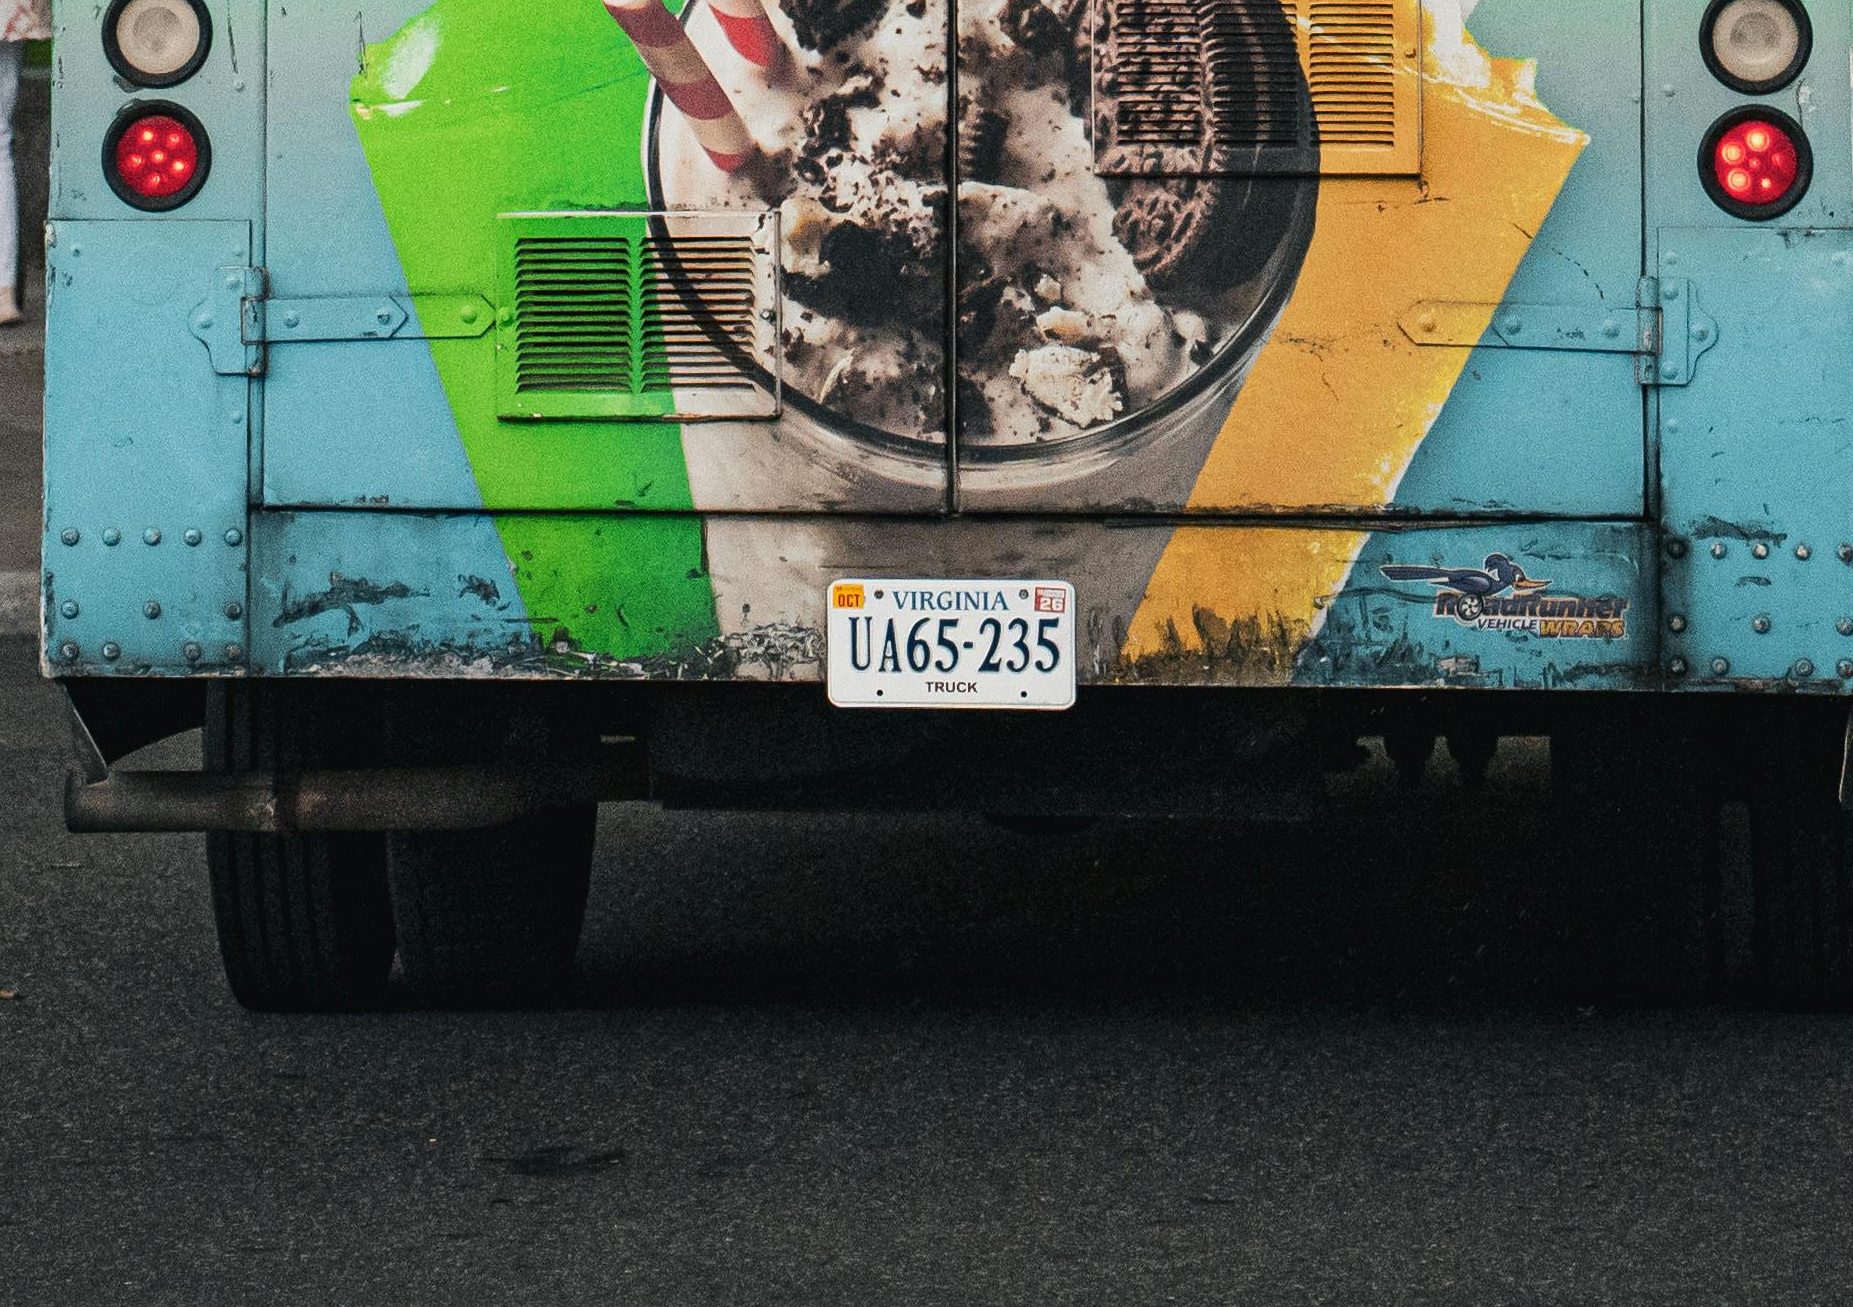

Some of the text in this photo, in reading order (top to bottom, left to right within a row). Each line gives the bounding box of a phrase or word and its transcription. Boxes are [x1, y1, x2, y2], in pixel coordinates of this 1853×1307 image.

[838, 594, 859, 607] OCT
[892, 591, 1008, 611] VIRGINIA
[1039, 597, 1064, 611] 26
[1477, 618, 1624, 638] VEHICLE WRAPS
[848, 616, 1060, 673] UA65-235
[926, 682, 977, 693] TRUCK
